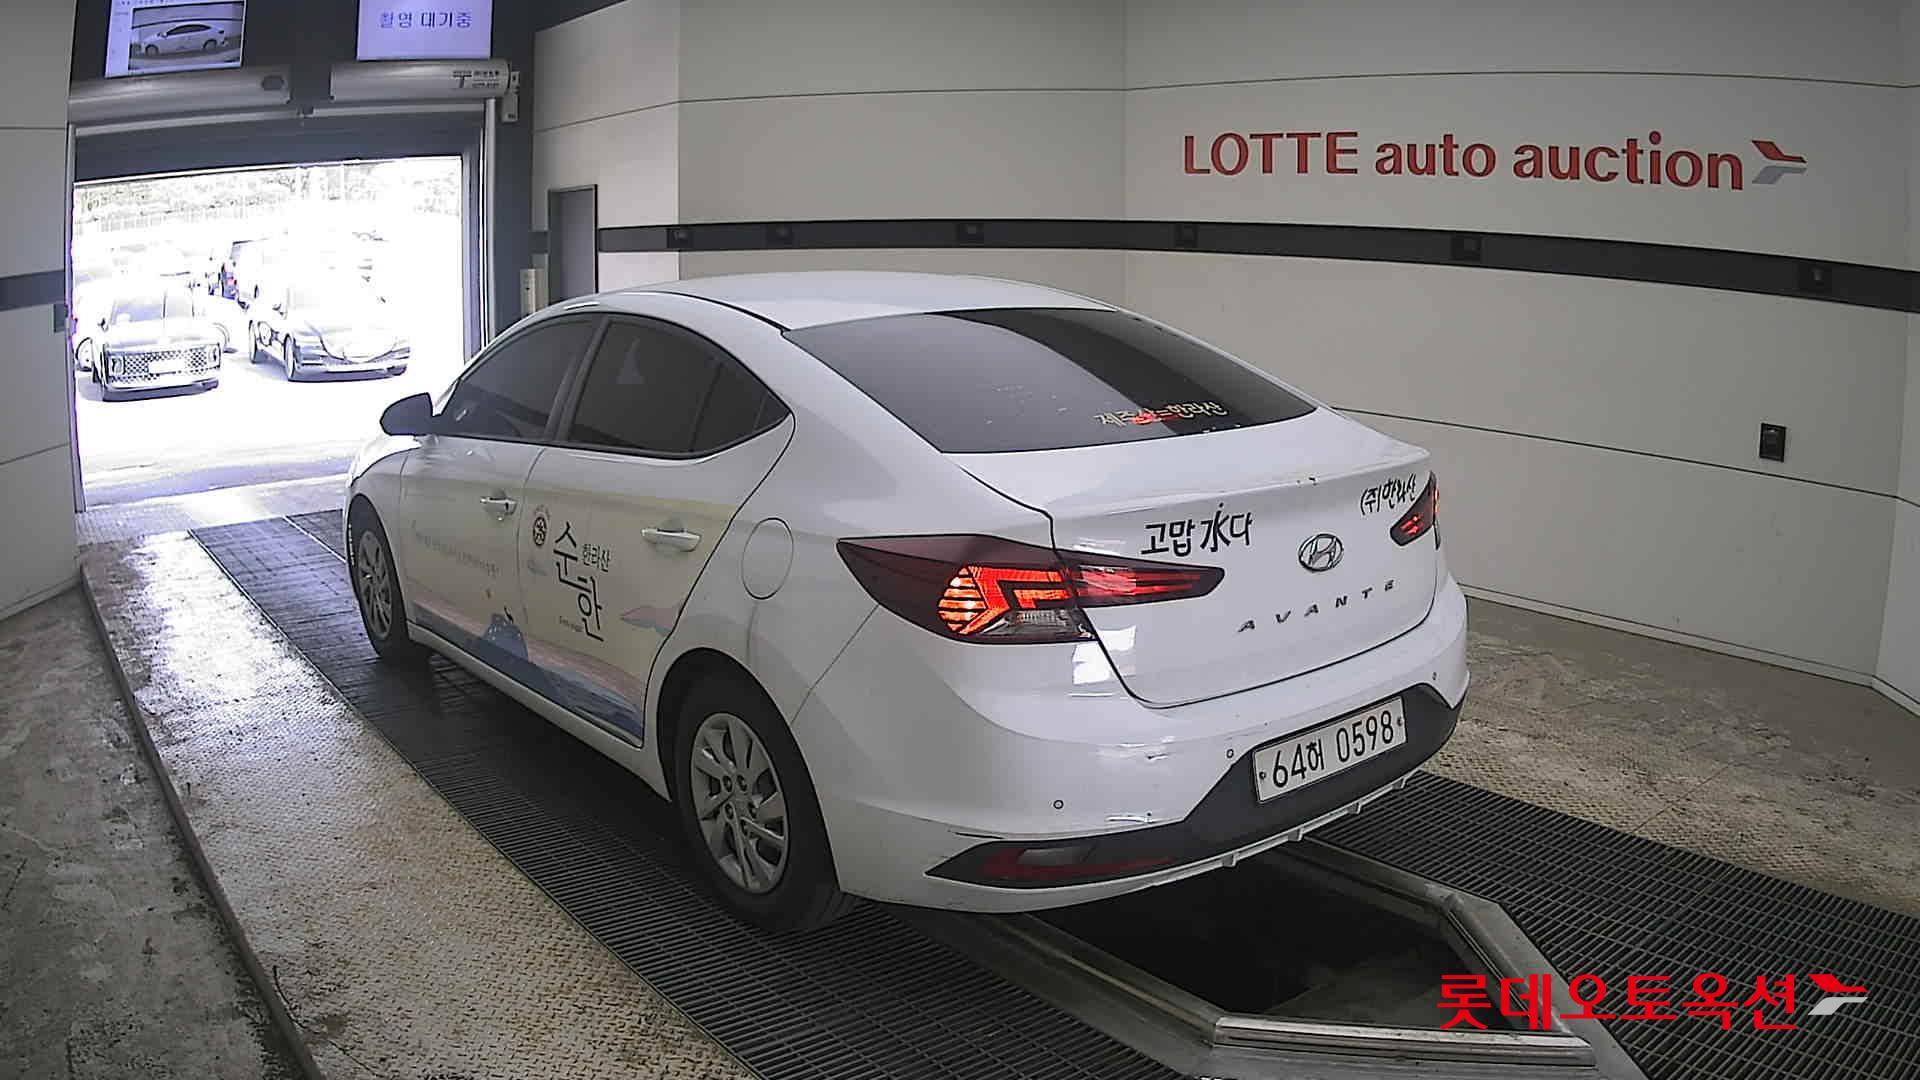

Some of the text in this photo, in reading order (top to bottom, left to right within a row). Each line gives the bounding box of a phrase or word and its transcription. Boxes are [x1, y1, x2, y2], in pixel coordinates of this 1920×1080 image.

[421, 11, 472, 29] 대기중
[1183, 130, 1744, 191] LOTTE auto auction
[583, 543, 610, 573] 한라산
[1237, 579, 1395, 633] AVANTE
[1272, 710, 1394, 788] 64허 0598
